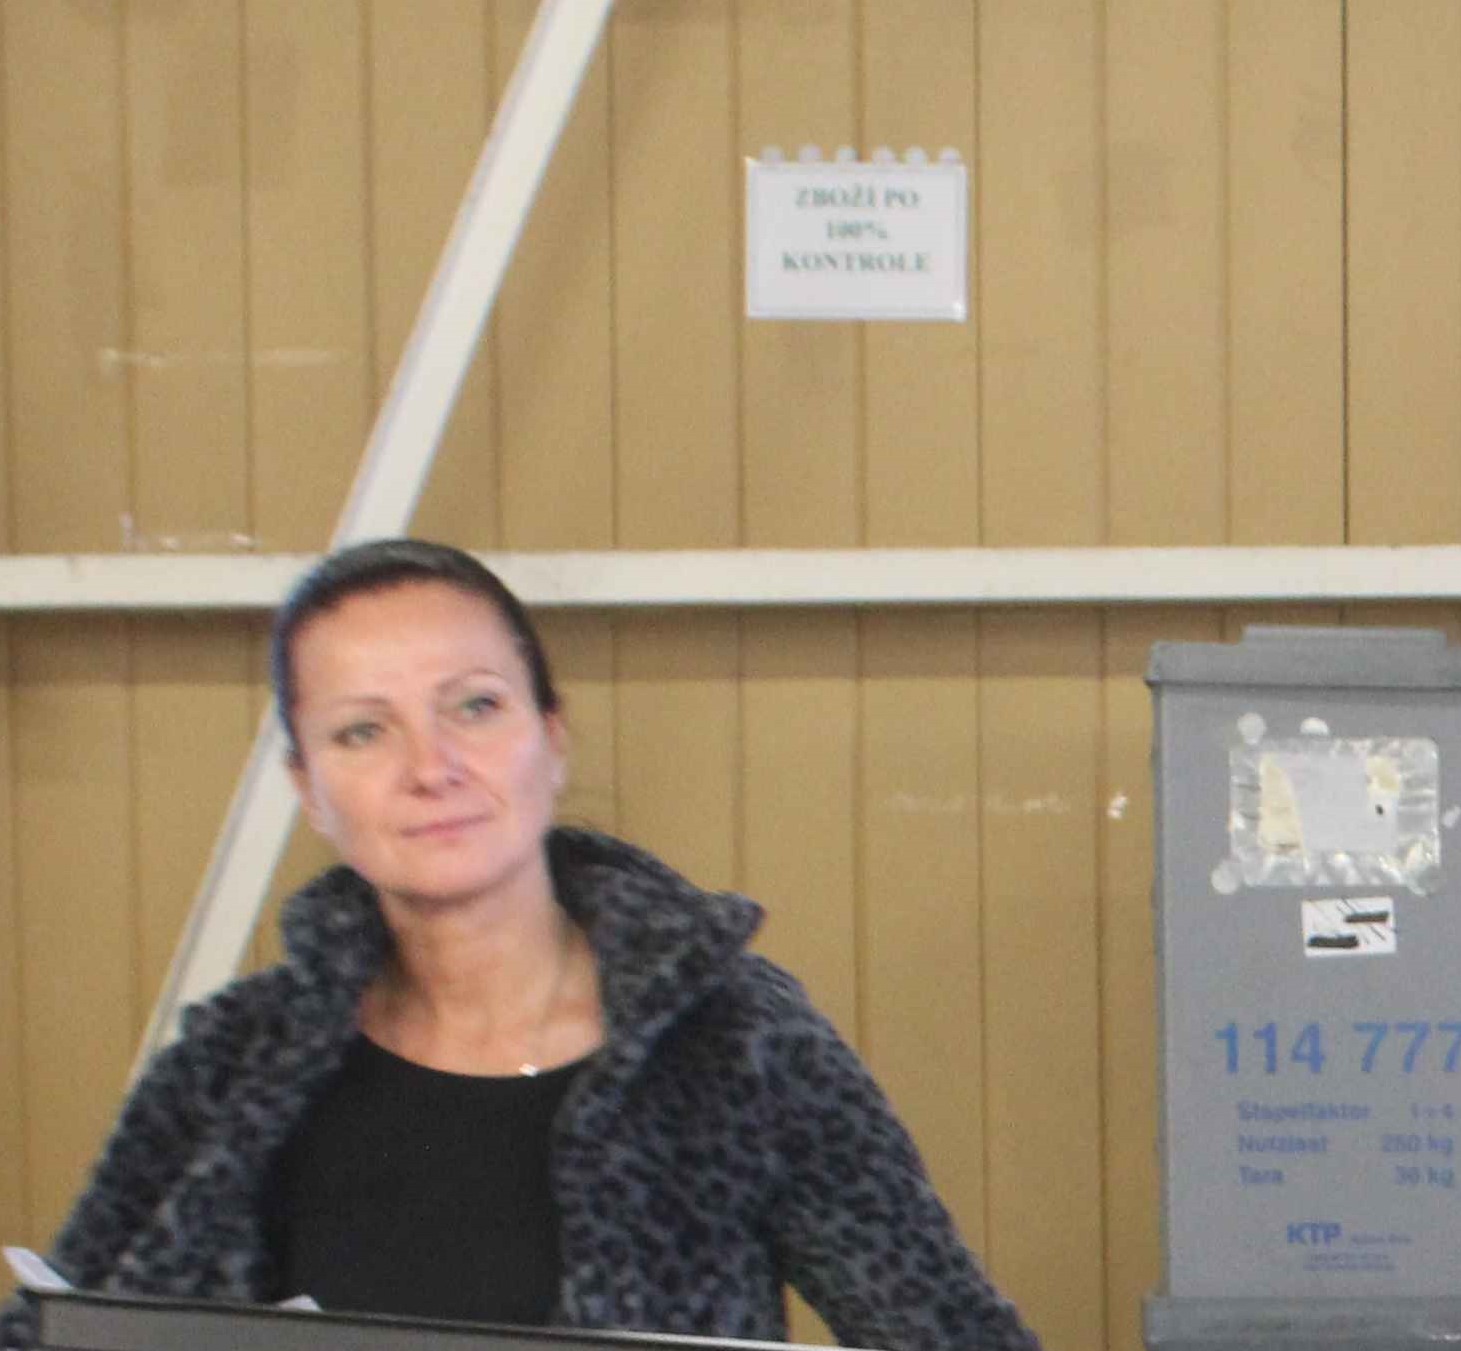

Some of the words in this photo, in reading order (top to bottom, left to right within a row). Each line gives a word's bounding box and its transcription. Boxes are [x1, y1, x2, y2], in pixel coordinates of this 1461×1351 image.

[884, 188, 921, 208] PO
[825, 220, 888, 240] 100%
[781, 254, 928, 272] KONTROLE
[1215, 1022, 1326, 1074] 114
